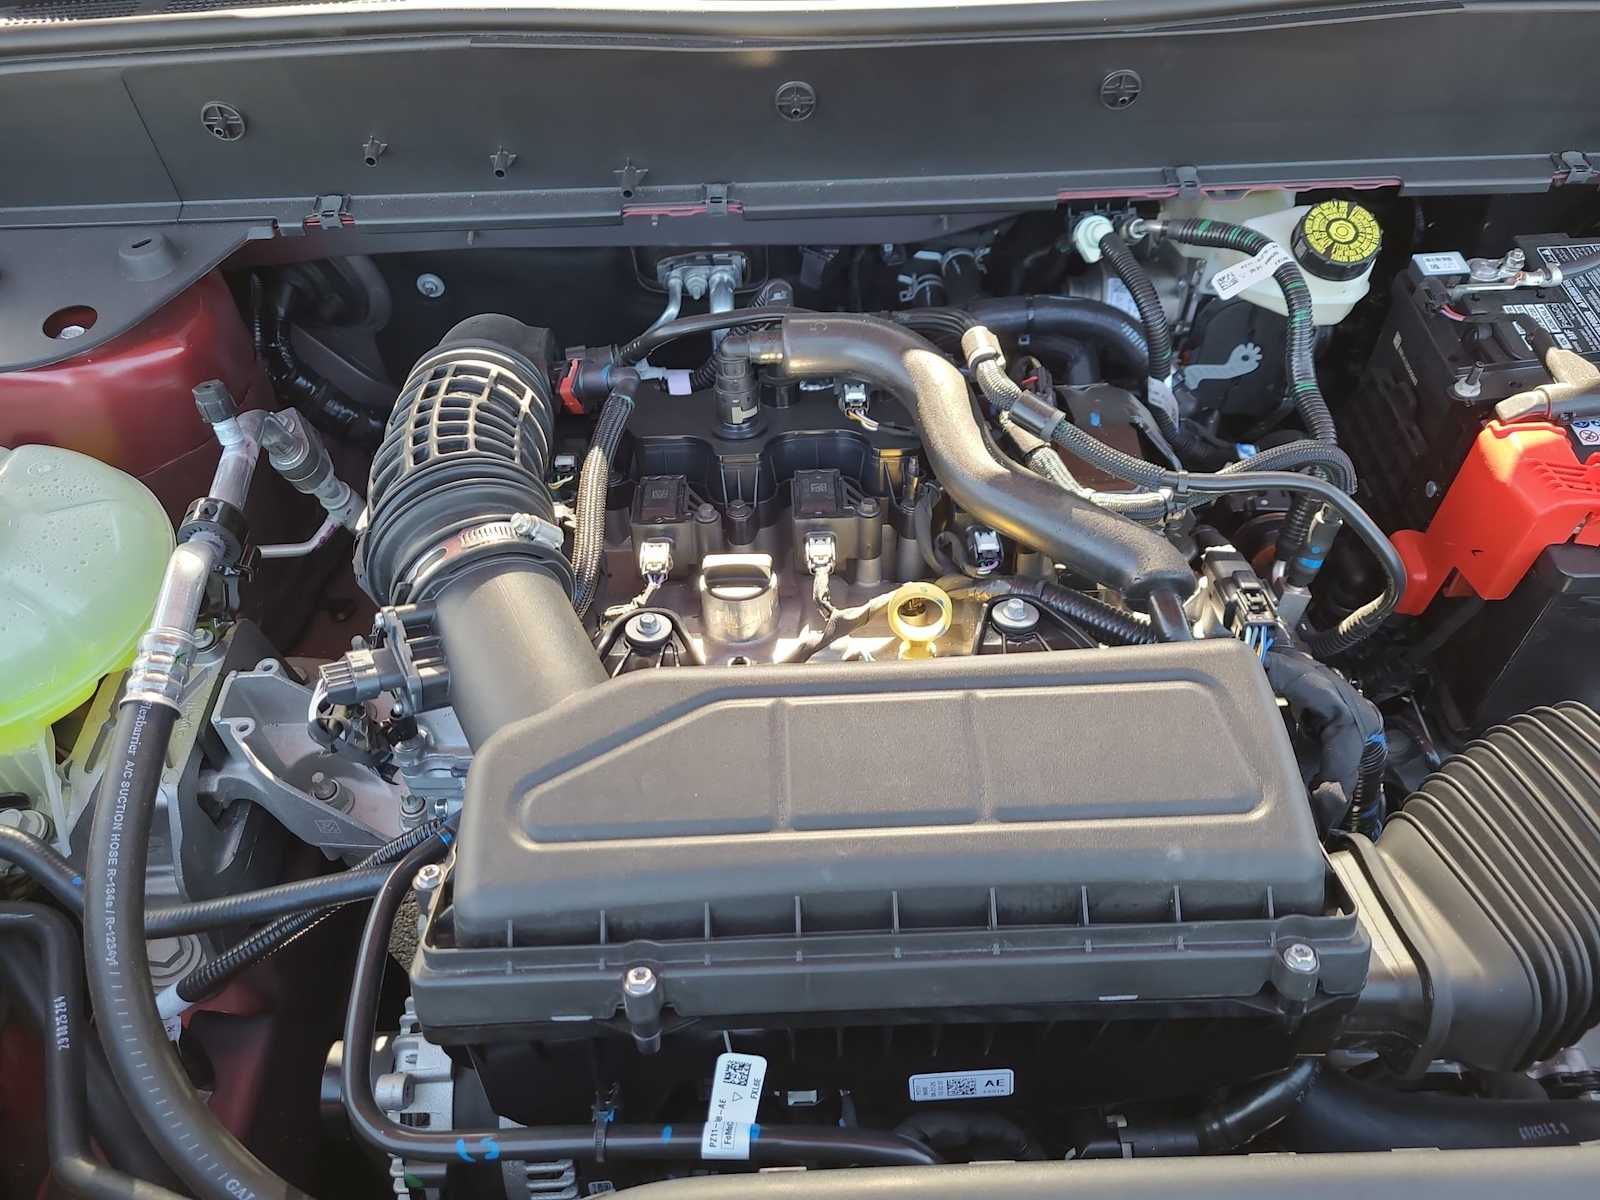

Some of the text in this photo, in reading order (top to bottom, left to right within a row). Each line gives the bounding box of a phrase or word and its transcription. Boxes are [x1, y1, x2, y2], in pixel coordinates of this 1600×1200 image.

[123, 760, 135, 778] A/C
[112, 780, 131, 830] SUCTION
[107, 833, 120, 865] HOSE
[985, 1079, 1005, 1087] AE
